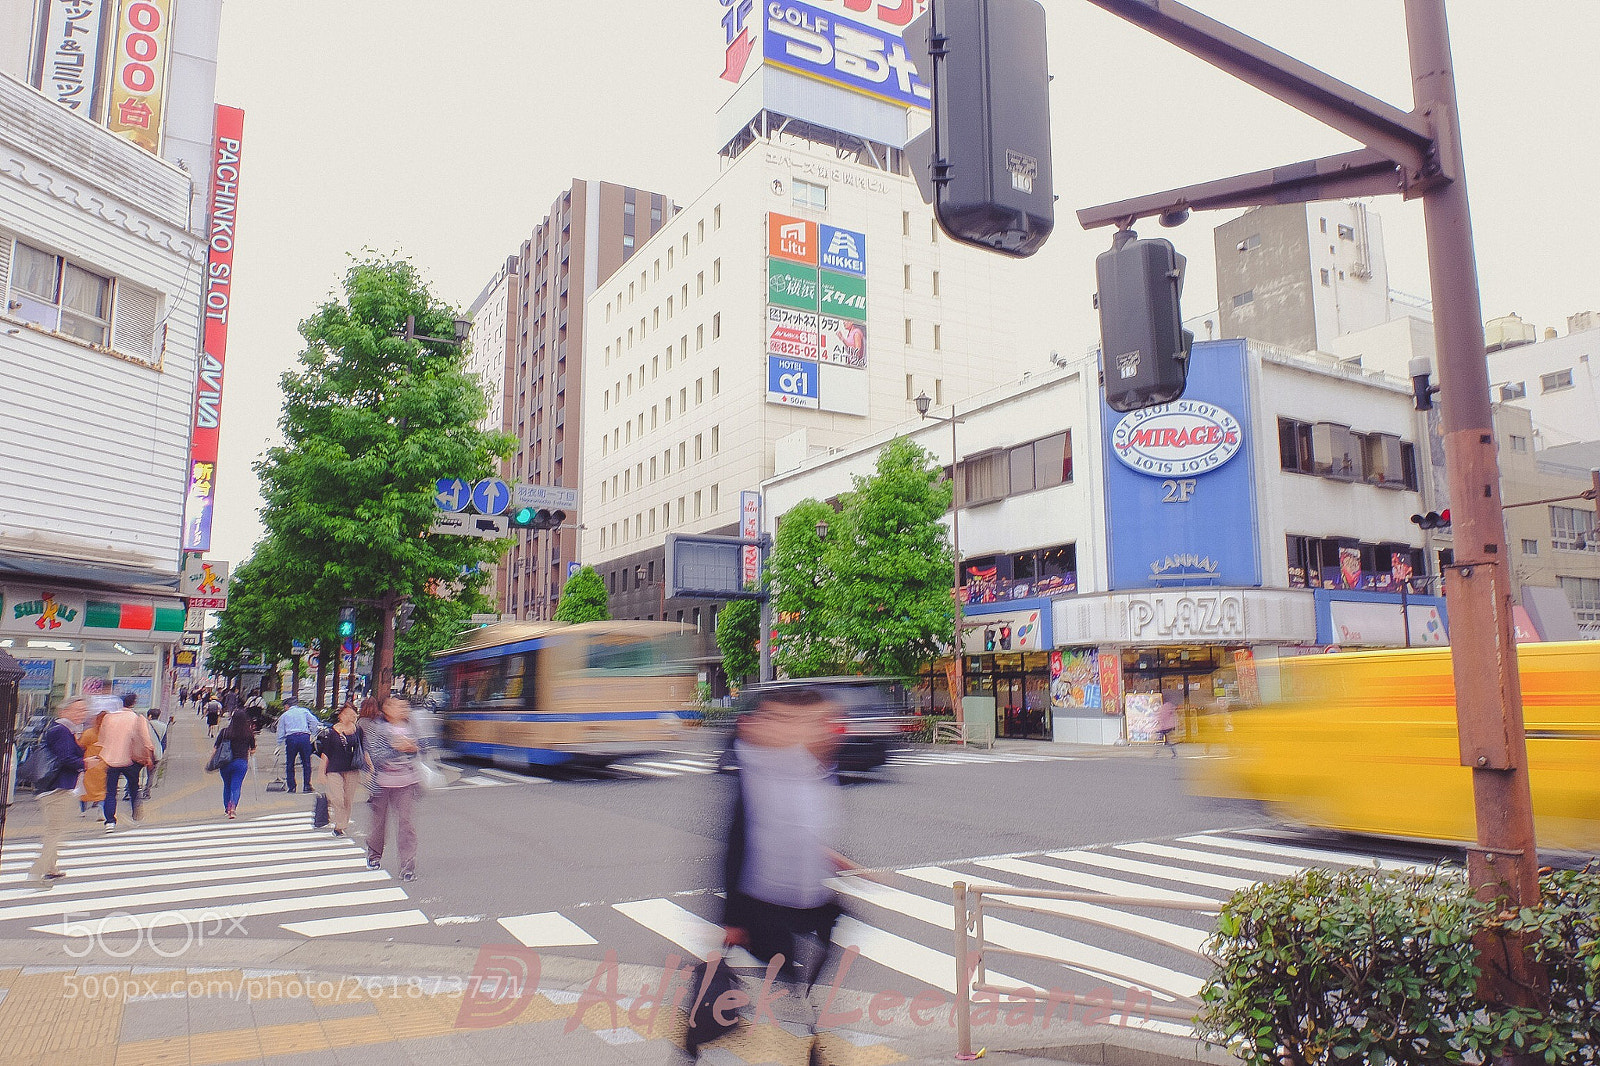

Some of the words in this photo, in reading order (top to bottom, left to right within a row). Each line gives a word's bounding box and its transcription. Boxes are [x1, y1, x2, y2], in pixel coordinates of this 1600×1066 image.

[768, 2, 829, 34] GOLF
[211, 137, 240, 253] PACHINKO
[781, 239, 806, 256] Litu
[823, 253, 863, 271] NIKKEI
[206, 262, 231, 325] SLOT
[821, 288, 866, 310] スタイル
[782, 310, 817, 329] フィットネス
[822, 318, 840, 333] クラブ
[779, 360, 803, 371] HOTEL
[197, 352, 223, 428] AVIVA
[1134, 403, 1172, 422] SLOT
[1180, 401, 1219, 418] SLOT
[1115, 425, 1222, 449] MIRAGE
[1133, 457, 1173, 473] SLOT
[1180, 453, 1219, 473] SLOT
[1161, 479, 1197, 503] 2F
[1150, 553, 1219, 575] KANNAI
[1128, 597, 1242, 637] PLAZA
